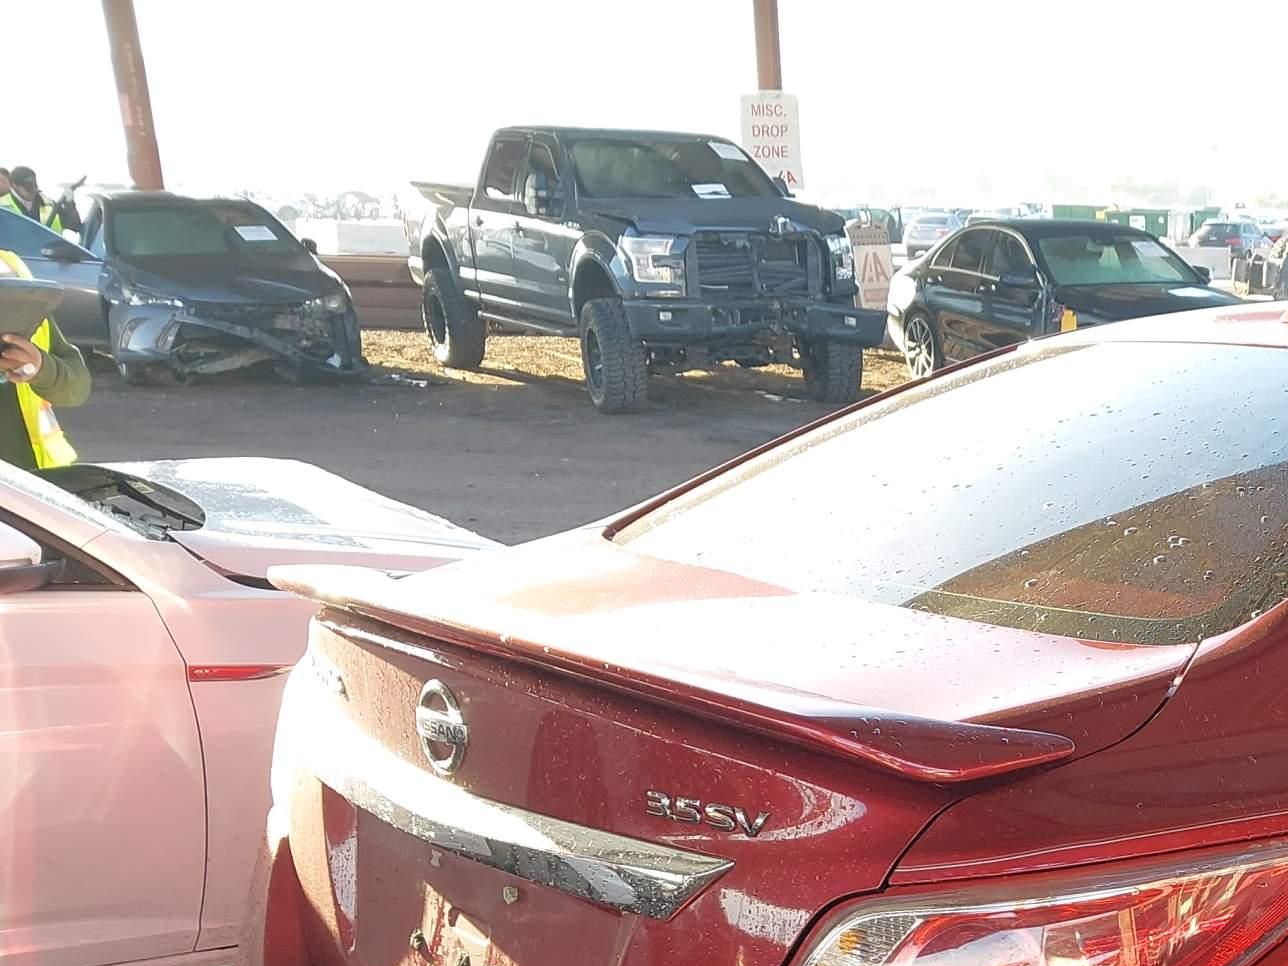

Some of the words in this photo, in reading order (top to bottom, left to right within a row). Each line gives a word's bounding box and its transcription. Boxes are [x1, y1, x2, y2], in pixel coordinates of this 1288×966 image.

[751, 103, 787, 117] MISC.
[751, 124, 788, 137] DROP
[753, 145, 789, 159] ZONE
